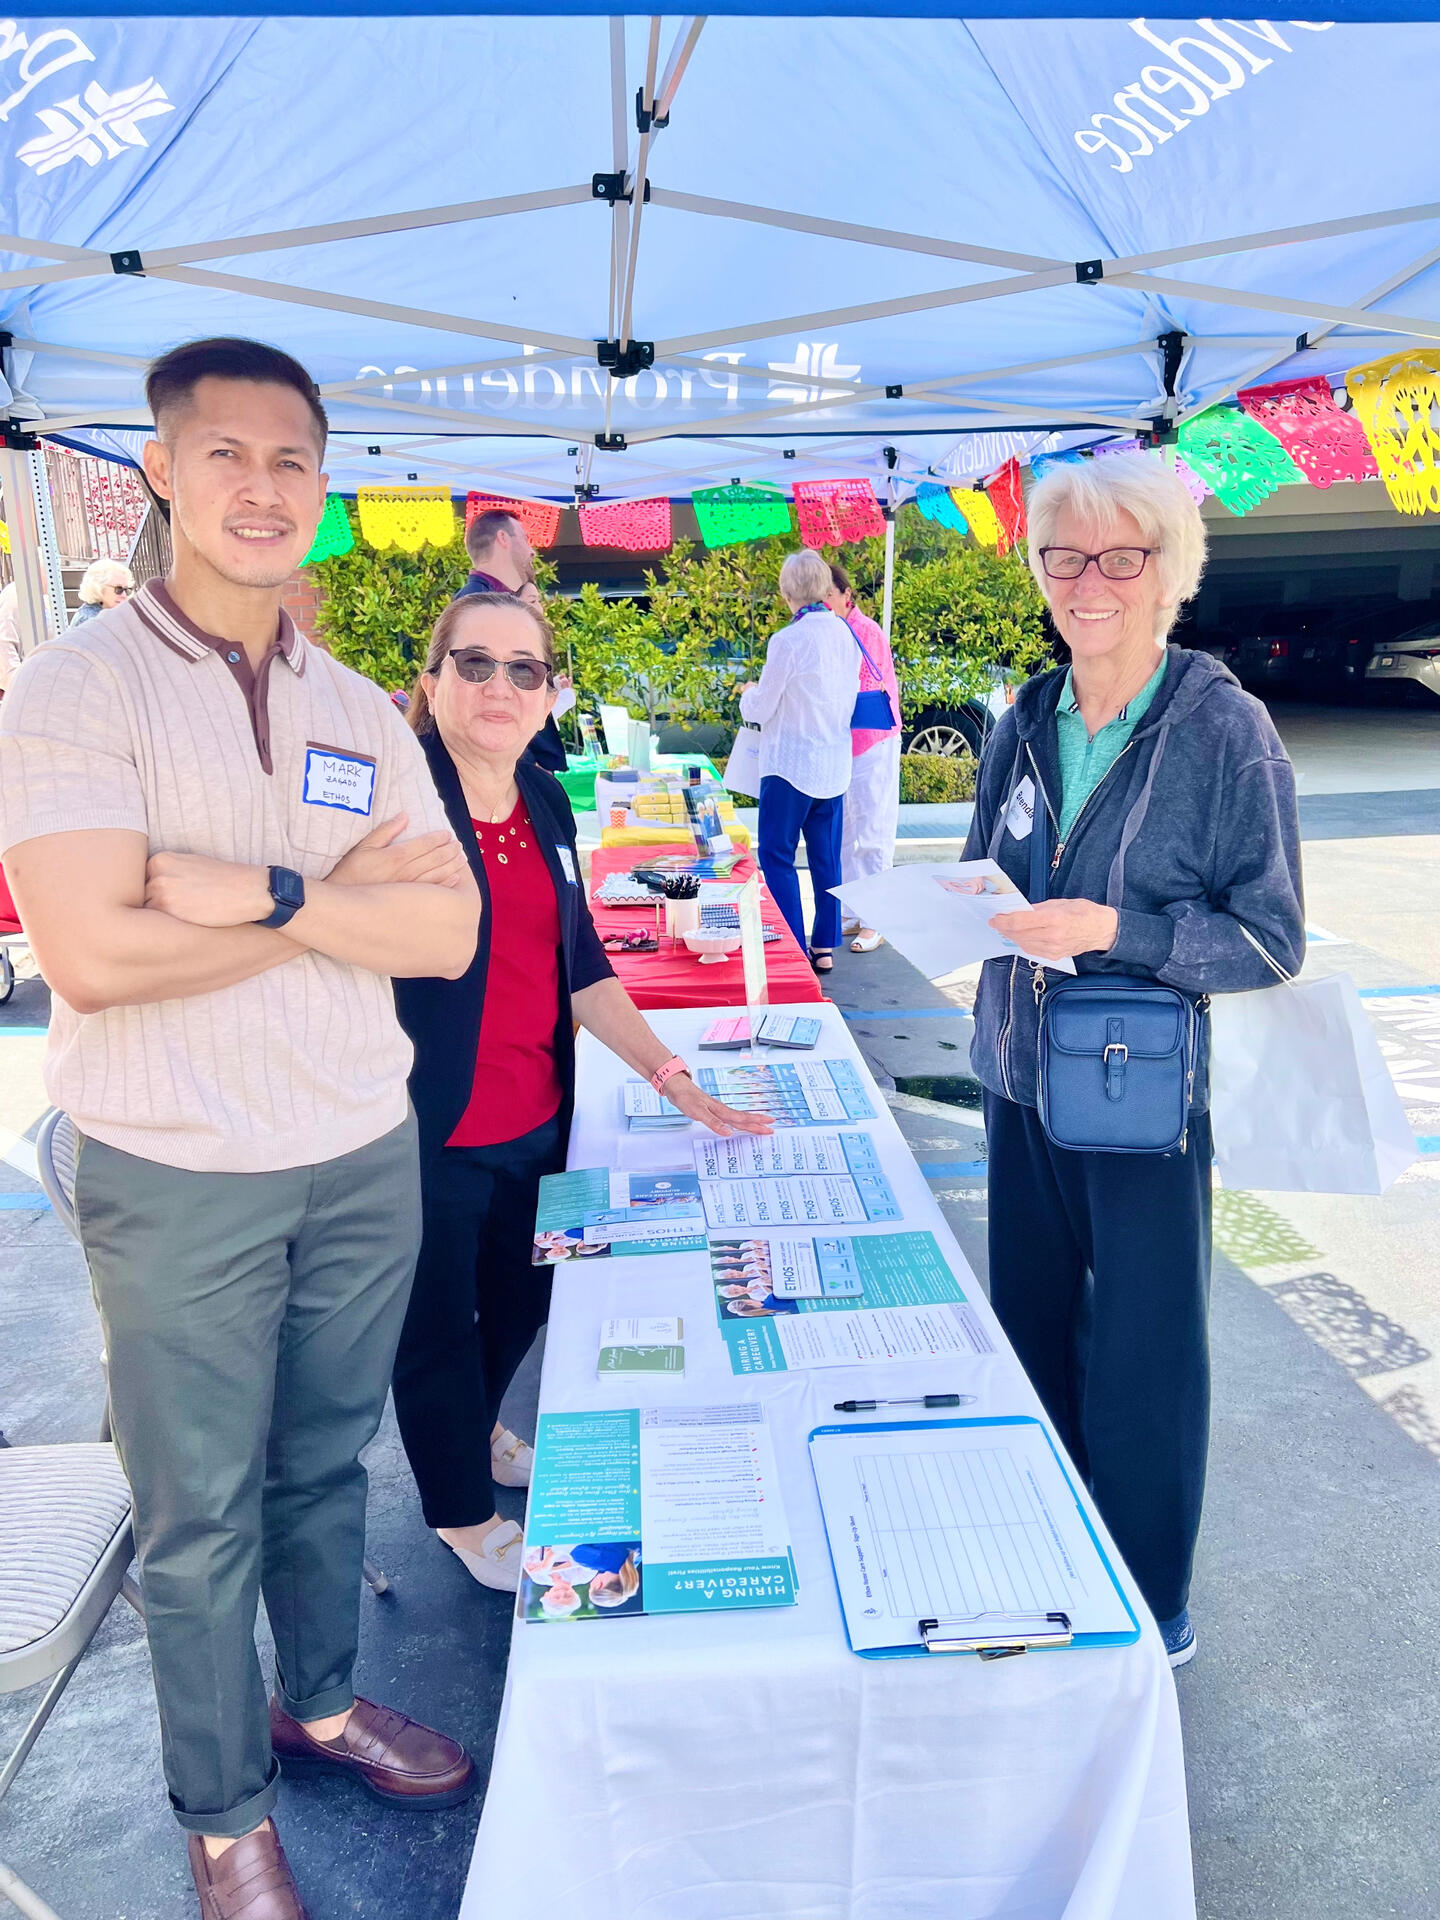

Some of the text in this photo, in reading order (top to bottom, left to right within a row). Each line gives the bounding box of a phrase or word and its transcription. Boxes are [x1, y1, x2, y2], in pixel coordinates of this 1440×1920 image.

[323, 760, 361, 777] MARK
[322, 790, 351, 804] ETHOS
[705, 1158, 717, 1176] ETHOS
[727, 1156, 738, 1173] ETHOS
[815, 1153, 828, 1170] ETHOS
[733, 1203, 746, 1222] ETHOS
[756, 1201, 770, 1220] ETHOS
[778, 1200, 793, 1220] ETHOS
[803, 1200, 818, 1219] ETHOS
[828, 1197, 844, 1217] ETHOS
[646, 1226, 694, 1235] ETHOS
[661, 1239, 703, 1248] HIRING
[782, 1266, 797, 1291] ETHOS
[745, 1328, 765, 1370] CAREGIVER?
[738, 1345, 753, 1371] HIRING
[667, 1569, 686, 1577] First!
[687, 1566, 742, 1575] Responsibilities
[674, 1575, 784, 1591] CAREGIVER?
[703, 1585, 786, 1599] HIRING A
